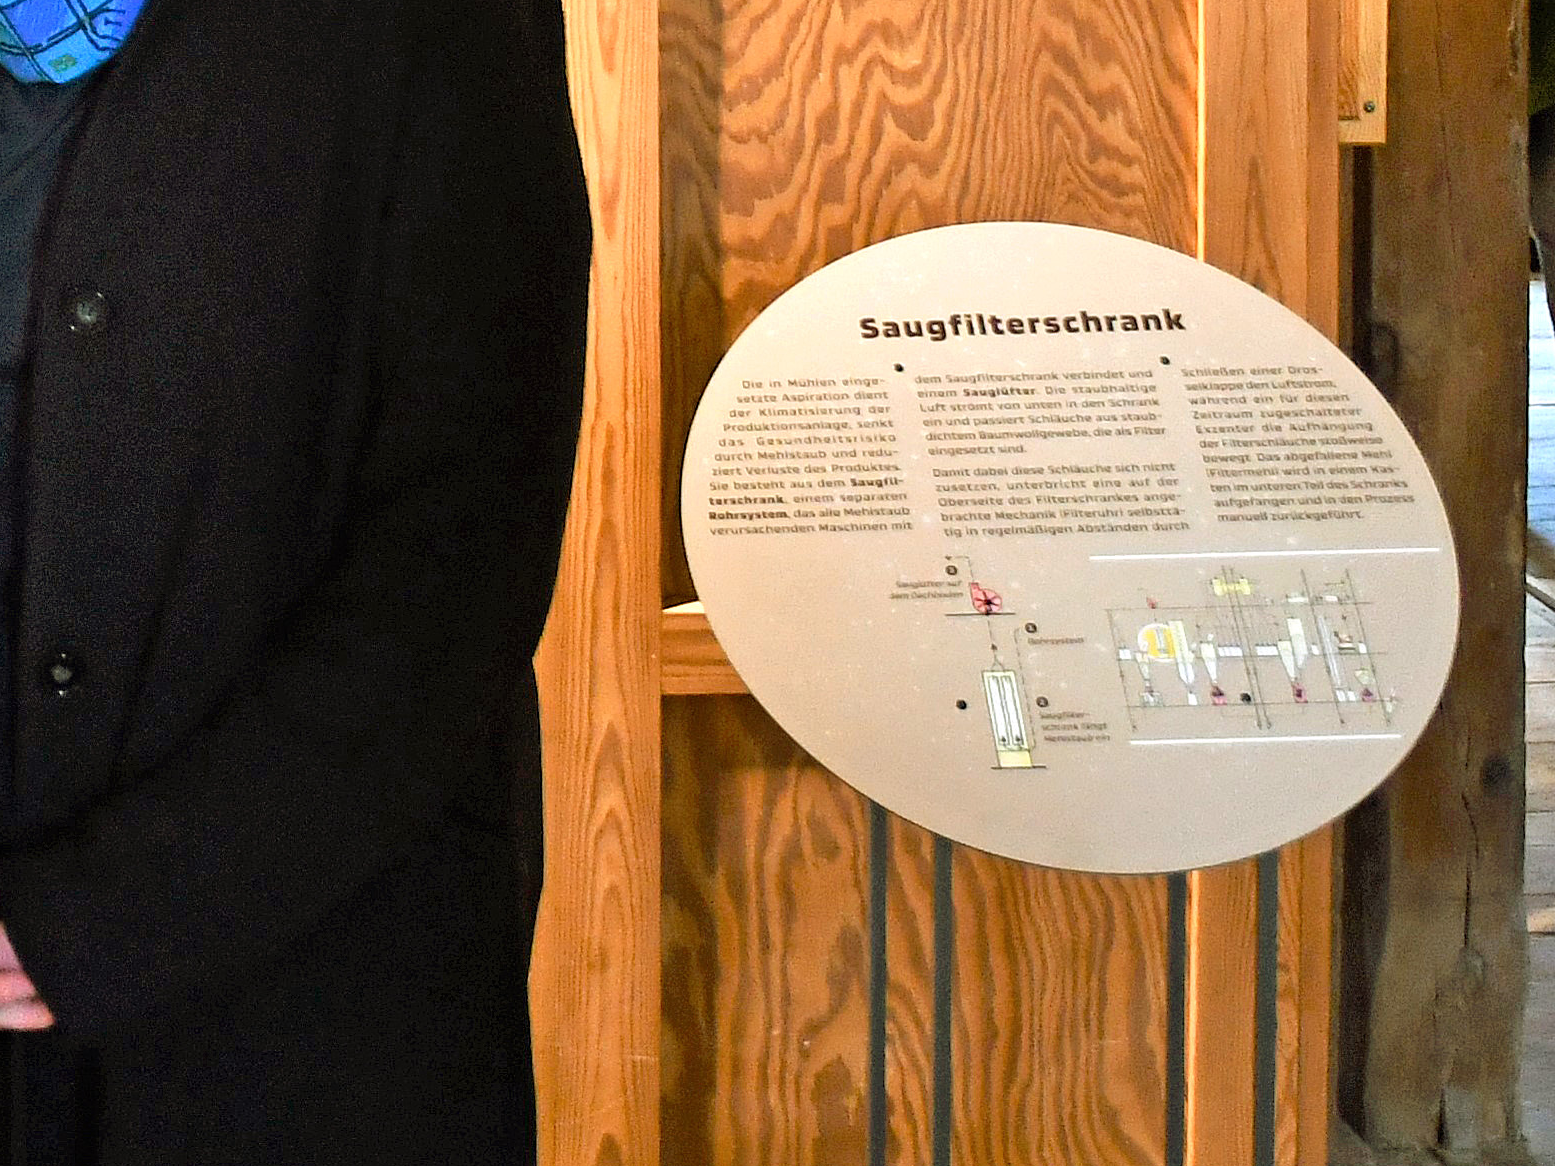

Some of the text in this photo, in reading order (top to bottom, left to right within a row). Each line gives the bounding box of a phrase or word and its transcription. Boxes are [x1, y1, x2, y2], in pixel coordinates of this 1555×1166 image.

[860, 308, 1187, 342] Saugfilterschrank
[743, 377, 885, 389] Die in Mühlen einge-
[737, 390, 888, 403] setzte Aspiration dient
[729, 405, 890, 417] der Klimatisierung der
[723, 418, 894, 432] Produktionsanlage, senkt
[719, 433, 896, 446] das Gesundheitsrisiko
[715, 447, 898, 461] durch Mehlstaub und redu-
[712, 462, 900, 475] ziert Verluste des Produktes.
[709, 481, 729, 490] Sie
[734, 479, 785, 489] besteht
[818, 479, 845, 487] dem
[850, 476, 903, 488] Saugfil-
[709, 492, 907, 505] terschrank, einem separaten
[709, 506, 910, 521] Rohrsystem, das alle Mehlstaub
[710, 520, 912, 534] verursachenden Maschinen mit
